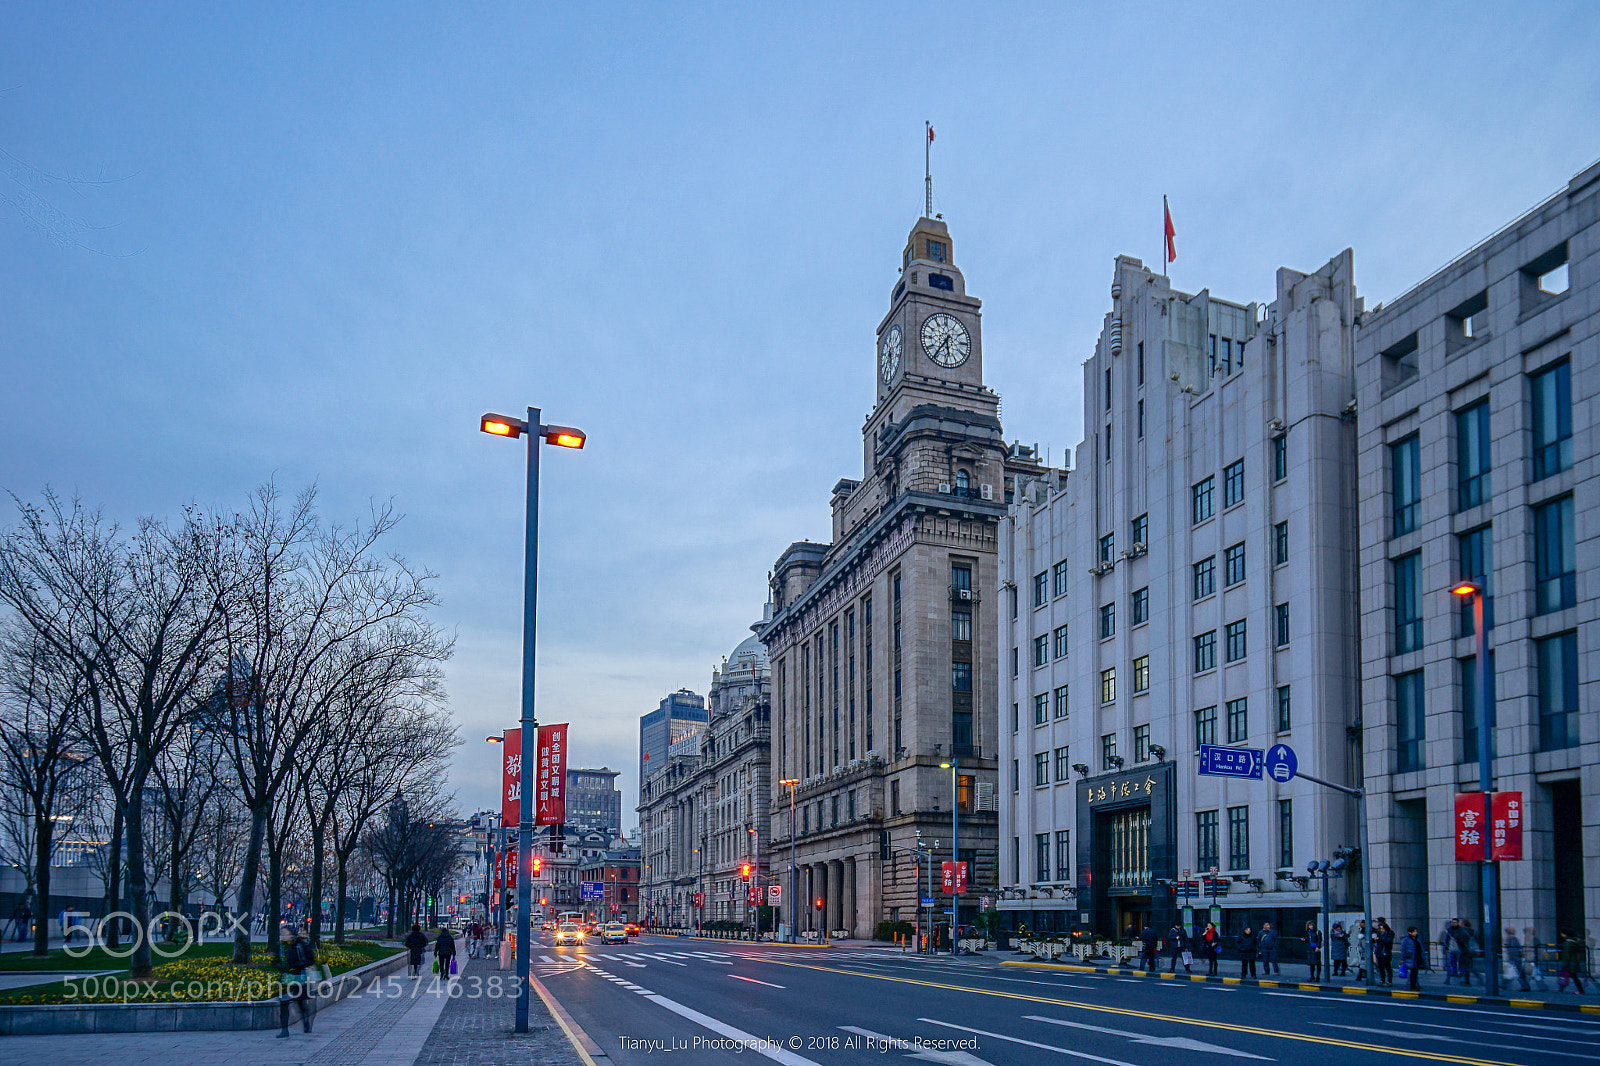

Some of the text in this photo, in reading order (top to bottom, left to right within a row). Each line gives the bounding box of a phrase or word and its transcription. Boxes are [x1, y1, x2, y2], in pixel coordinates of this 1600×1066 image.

[550, 731, 561, 798] 创全国文明城
[1214, 753, 1246, 764] 汉口路
[540, 746, 550, 812] 做黄浦文明人
[1508, 800, 1519, 828] 中国梦
[1494, 819, 1505, 847] 我的梦
